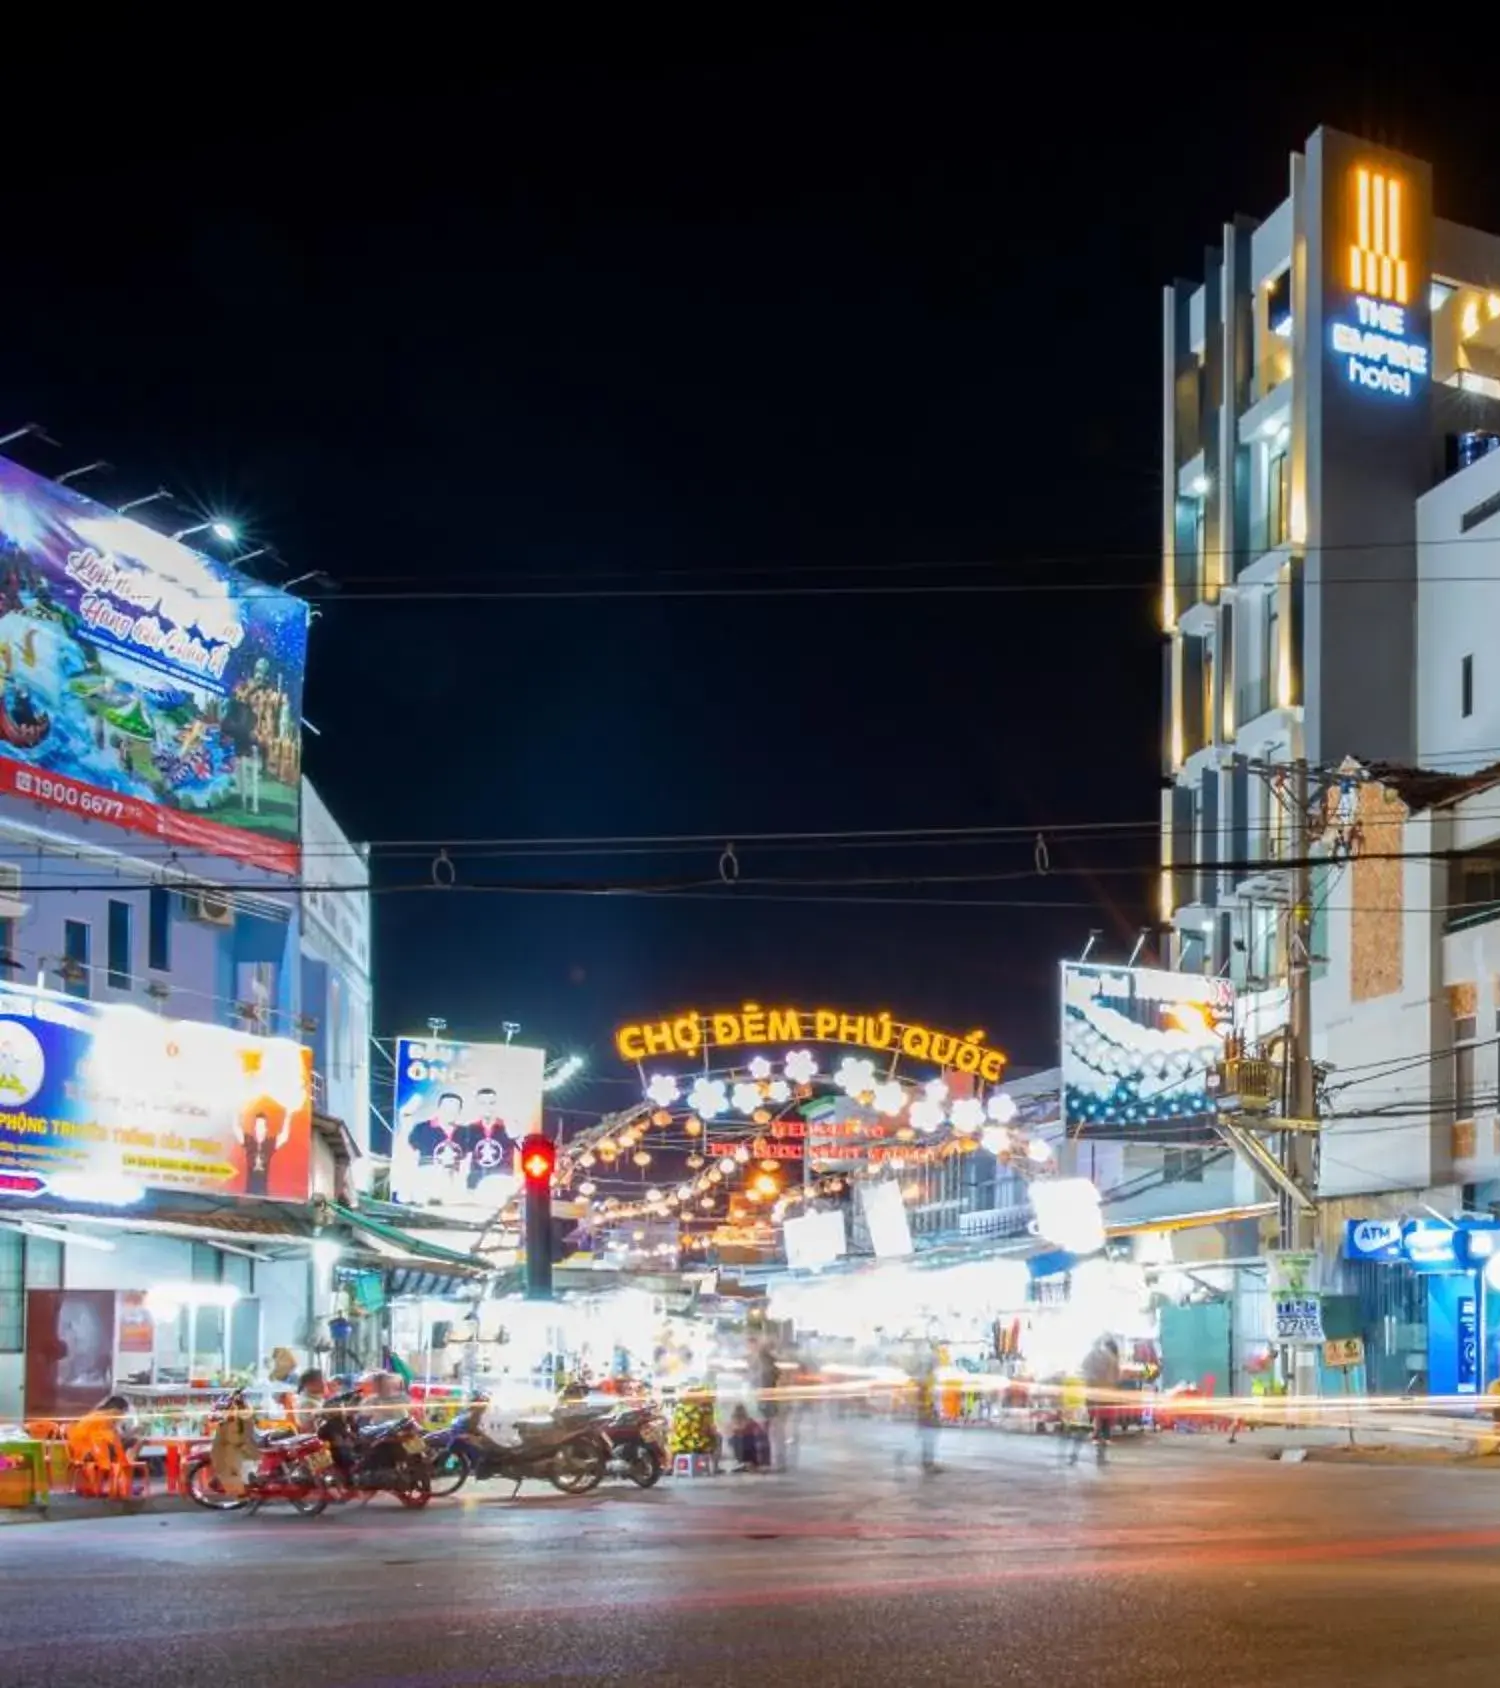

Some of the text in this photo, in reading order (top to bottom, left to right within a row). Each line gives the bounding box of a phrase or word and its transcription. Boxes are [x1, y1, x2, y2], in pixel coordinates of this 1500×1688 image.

[1356, 296, 1404, 334] THE
[1333, 323, 1427, 374] EMPIRE
[1349, 358, 1410, 396] hotel
[34, 778, 124, 818] 1900 6677
[617, 1004, 1007, 1082] CHỢ ĐÊM PHÚ QUỐC
[1361, 1227, 1390, 1241] ATM
